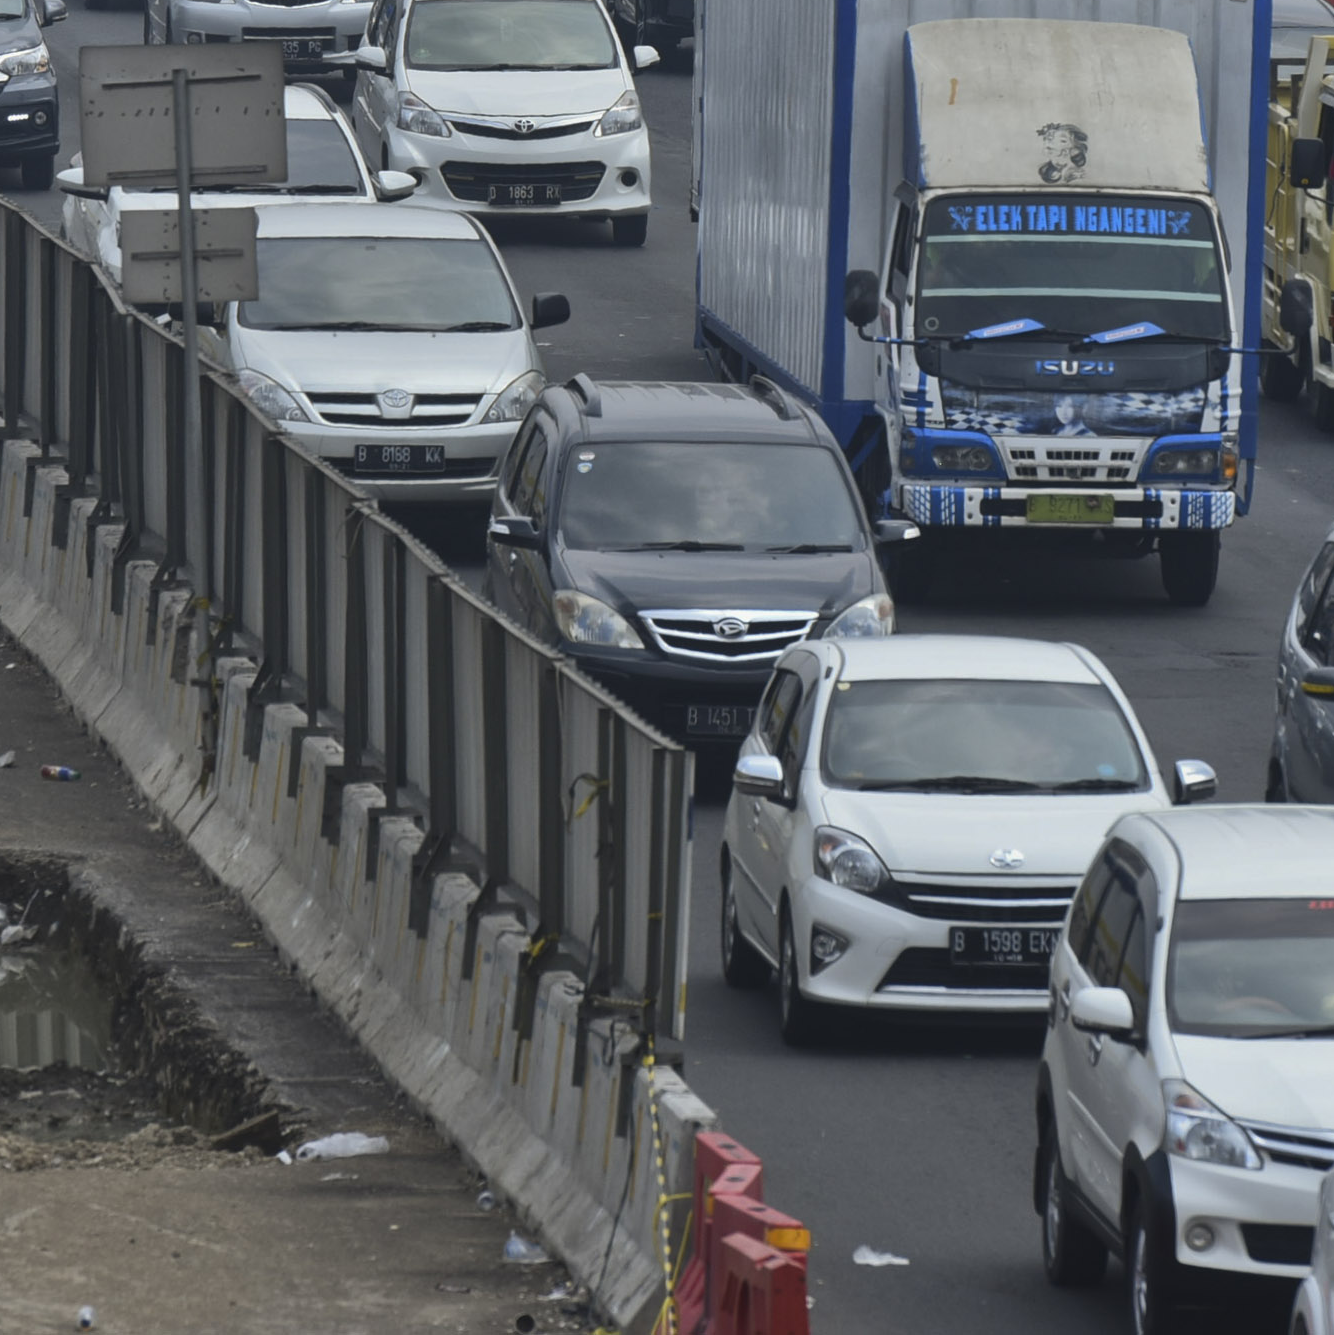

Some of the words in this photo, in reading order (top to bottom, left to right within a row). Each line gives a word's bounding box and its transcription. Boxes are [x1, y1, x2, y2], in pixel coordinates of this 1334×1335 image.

[489, 186, 497, 199] D
[508, 186, 534, 199] 1863
[975, 205, 1022, 231] ELEK
[1025, 205, 1067, 232] TAPI
[1074, 206, 1167, 235] NGANGENI
[1035, 360, 1115, 376] ISUZU
[358, 446, 367, 462] B
[381, 446, 411, 463] 8168
[425, 447, 442, 463] KK
[687, 707, 698, 726] B
[707, 707, 738, 726] 1451
[954, 931, 965, 953] B
[983, 931, 1022, 953] 1598
